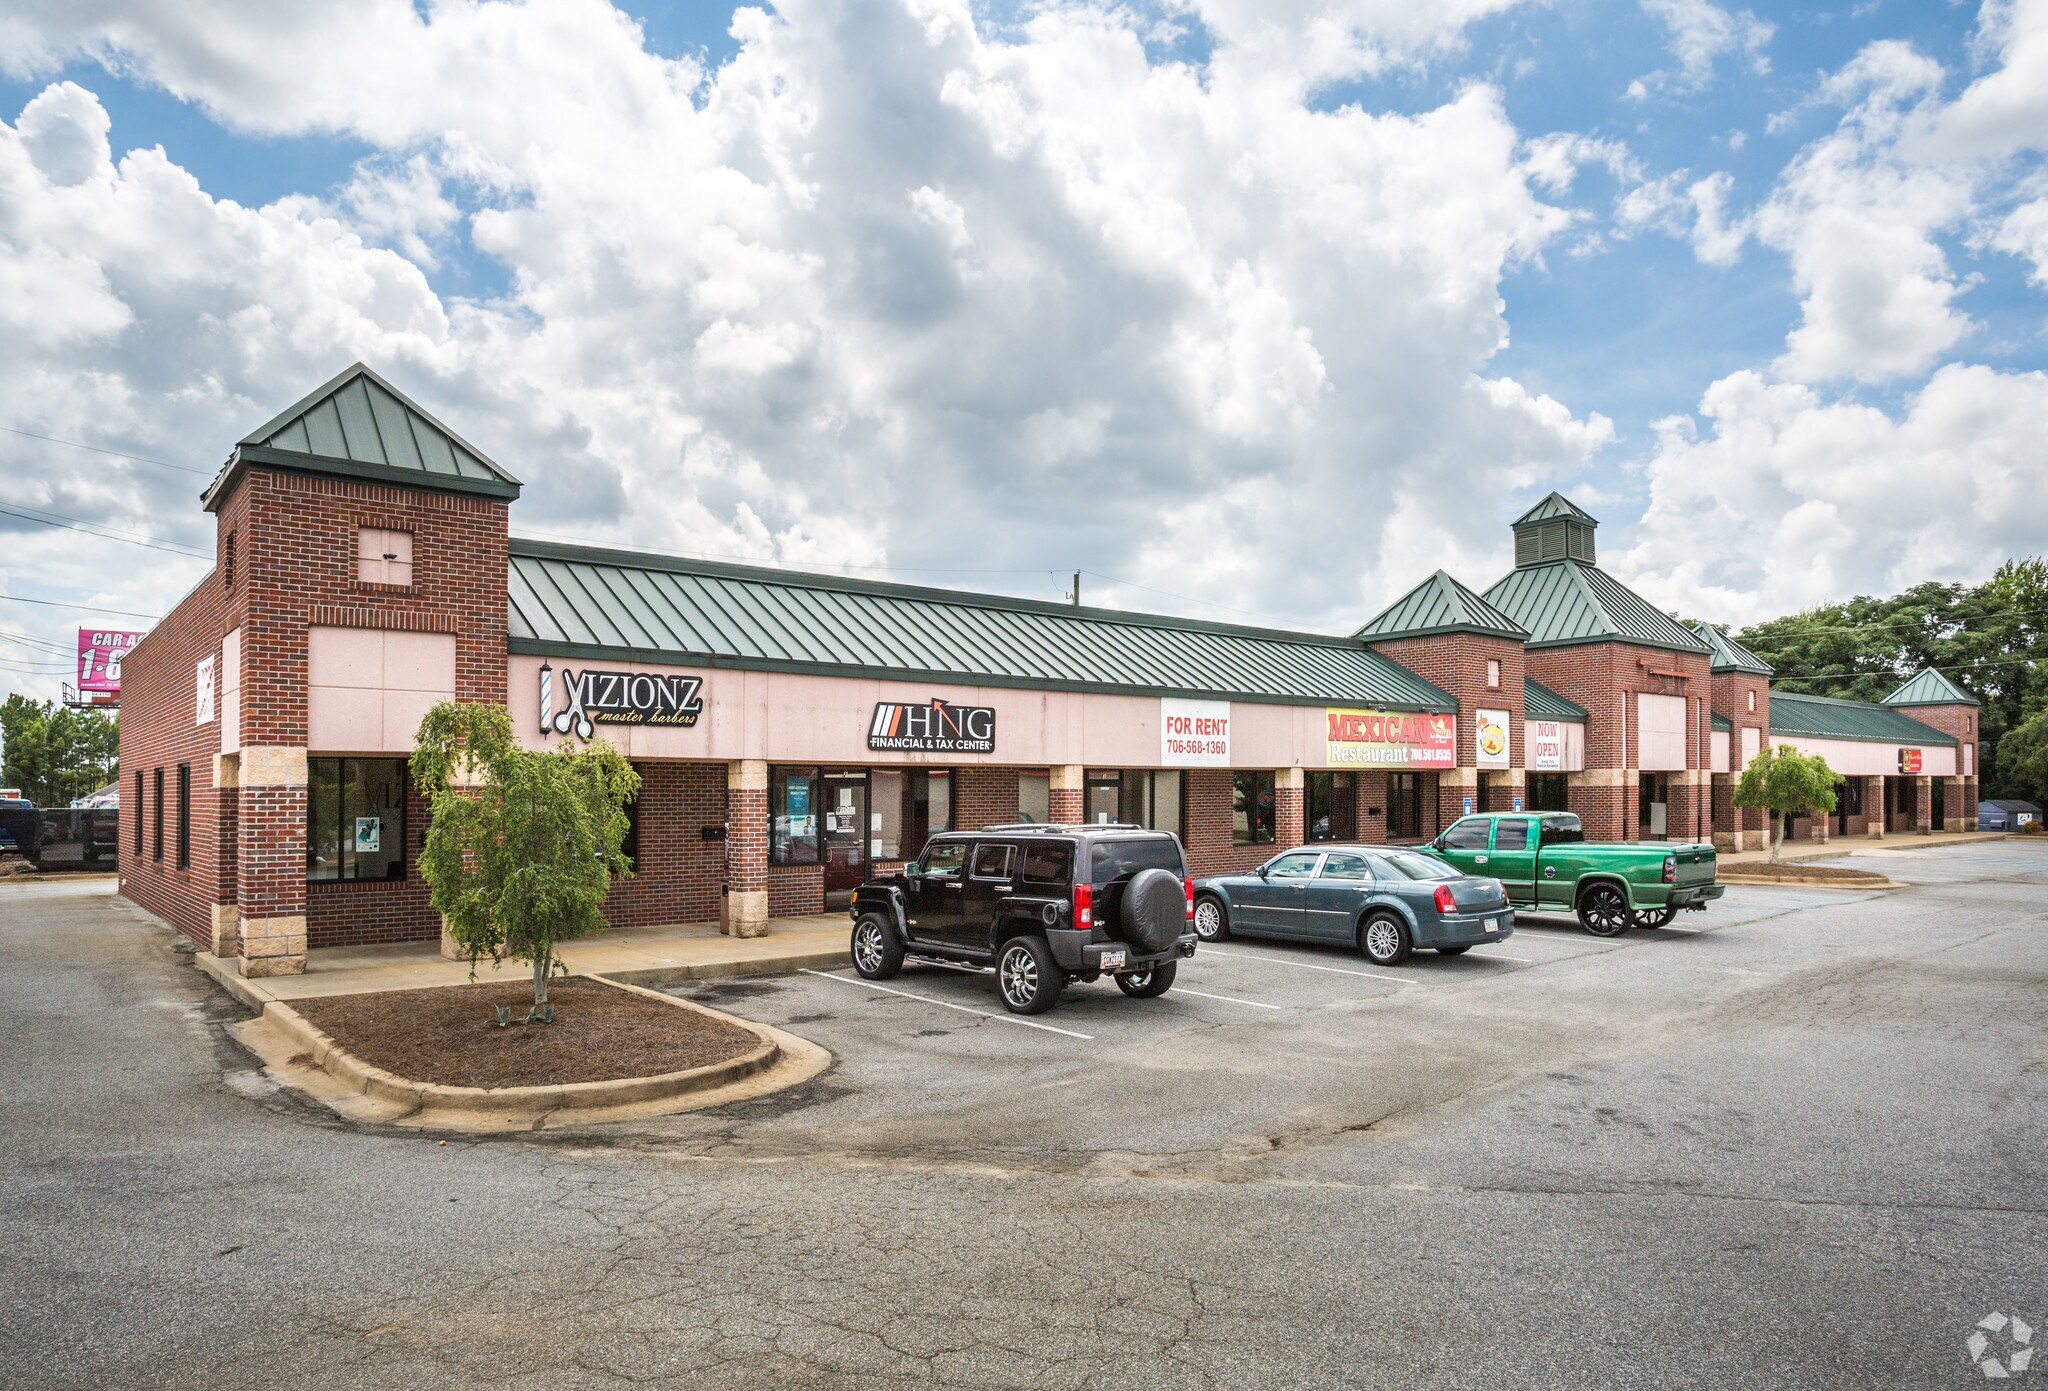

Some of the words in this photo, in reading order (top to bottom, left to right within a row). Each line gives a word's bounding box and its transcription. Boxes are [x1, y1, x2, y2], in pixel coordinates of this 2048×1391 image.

[91, 632, 123, 646] CAR
[598, 709, 643, 722] master
[648, 709, 695, 724] barbers
[1167, 717, 1192, 735] FOR
[1195, 718, 1227, 735] RENT
[1328, 714, 1429, 744] MEXICAN
[1538, 723, 1557, 737] NOW
[872, 737, 925, 748] FINANCIAL
[926, 739, 933, 749] &
[936, 739, 953, 749] TAX
[956, 740, 990, 750] CENTER
[1167, 740, 1226, 754] 706-568-1360
[1537, 743, 1558, 757] OPEN
[1331, 743, 1409, 763] Restaurant
